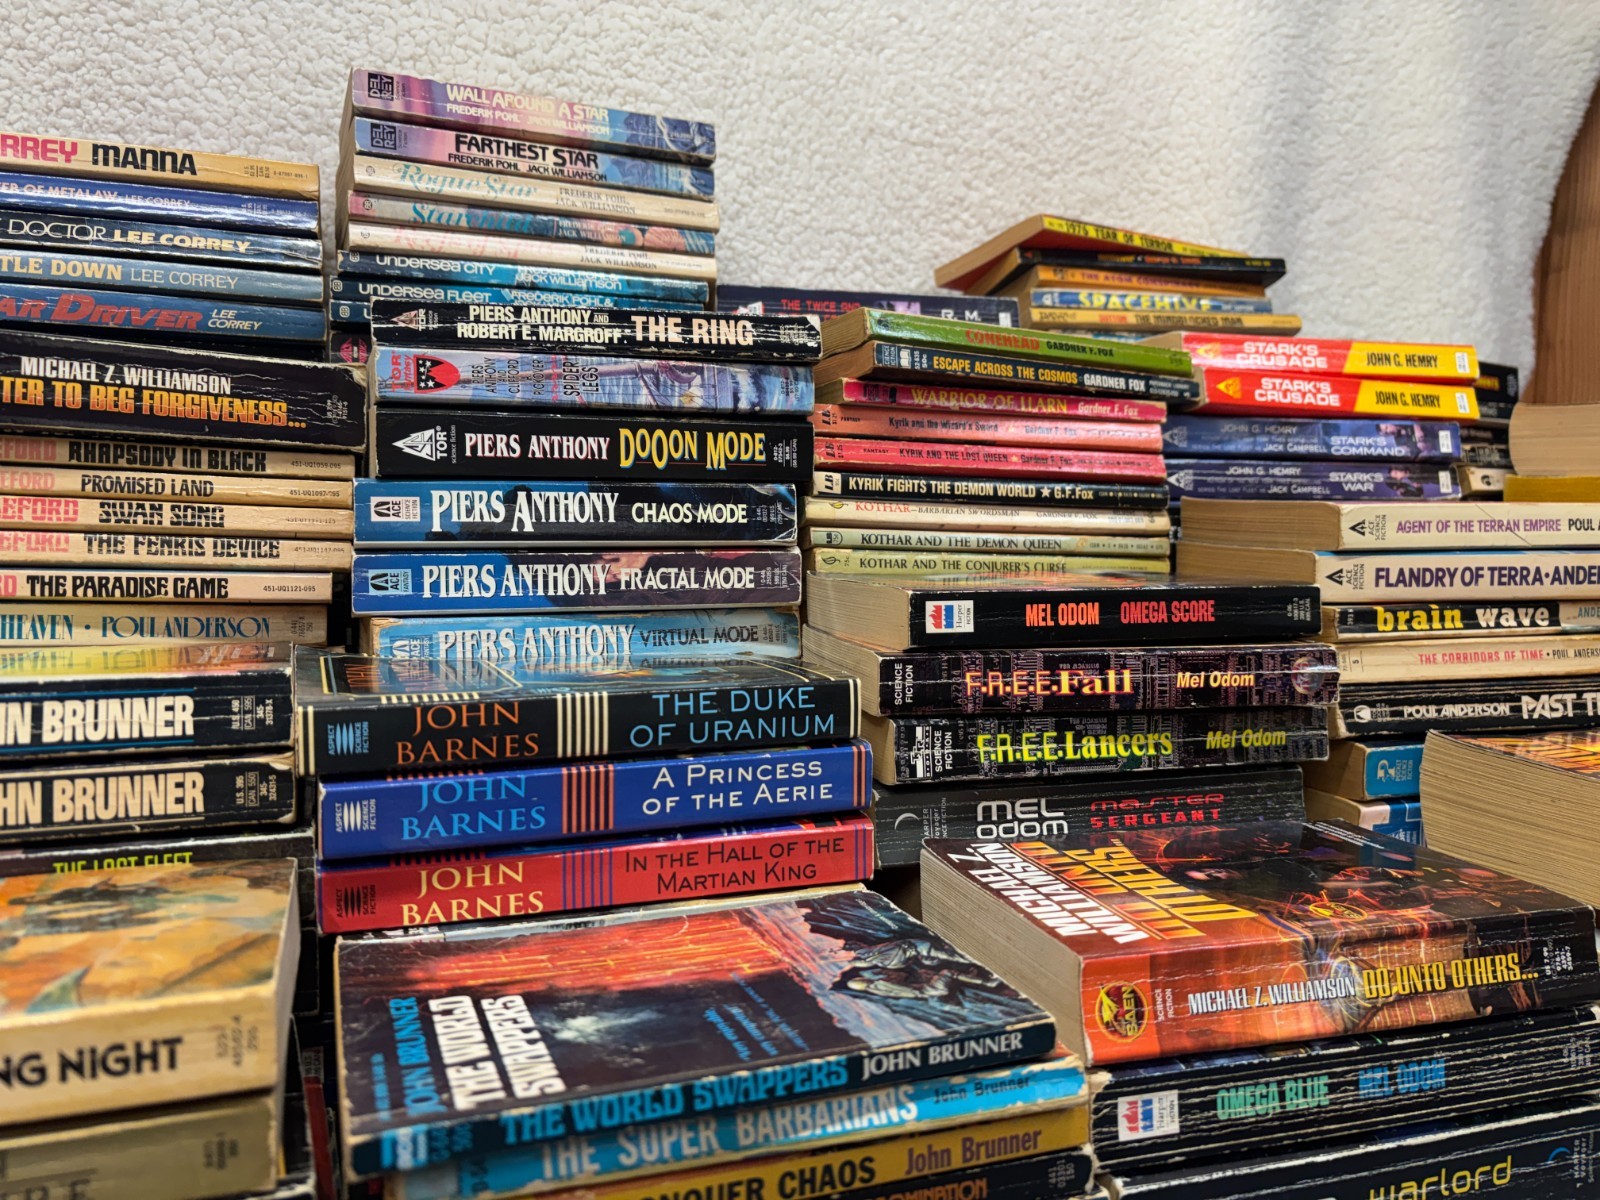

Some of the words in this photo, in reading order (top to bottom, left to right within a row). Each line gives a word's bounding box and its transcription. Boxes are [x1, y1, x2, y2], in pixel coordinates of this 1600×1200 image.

[455, 133, 550, 163] FARTHEST
[552, 148, 599, 170] STAR
[448, 153, 494, 168] FREDERIK
[496, 160, 521, 172] POHL
[526, 163, 551, 176] JACK
[551, 167, 608, 183] WILLIAMSON
[8, 219, 107, 240] DOCTOR
[113, 229, 156, 244] LEE
[160, 233, 251, 253] CORREY
[51, 293, 203, 330] DRIVER
[211, 309, 238, 319] LEE
[207, 319, 263, 331] CORREY
[469, 305, 515, 323] PIERS
[520, 307, 592, 326] ANTHONY
[593, 313, 610, 324] AND
[457, 322, 518, 340] ROBERT
[522, 324, 537, 341] E.
[539, 325, 622, 344] MARGROFF
[1243, 341, 1319, 356] STARK'S
[20, 356, 100, 382] MICHAEL
[104, 365, 121, 384] Z.
[123, 366, 231, 395] WILLIAMSON
[933, 355, 970, 373] ESCAPE
[974, 360, 1013, 377] ACROSS
[1017, 365, 1035, 380] THE
[1038, 369, 1078, 384] COSMOS
[1083, 373, 1126, 389] GARDNER
[1128, 378, 1146, 392] FOX
[1235, 353, 1328, 369] CRUSADE
[1366, 352, 1391, 367] JOHN
[1393, 353, 1403, 367] G.
[1405, 354, 1438, 369] HEMRY
[562, 360, 581, 397] SPIDER
[582, 366, 599, 393] LEGS
[1260, 377, 1331, 393] STARK'S
[1254, 389, 1341, 407] CRUSADE
[1375, 390, 1398, 405] JOHN
[1400, 393, 1410, 407] G.
[1410, 393, 1441, 408] HEMRY
[464, 432, 522, 458] PIERS
[527, 435, 610, 460] ANTHONY
[849, 477, 884, 492] KYRIK
[886, 477, 927, 493] FIGHTS
[930, 480, 951, 494] THE
[954, 481, 994, 496] DEMON
[997, 484, 1036, 498] WORLD
[1329, 471, 1384, 482] STARK'S
[1341, 482, 1374, 492] WAR
[391, 500, 402, 518] ACE
[430, 490, 506, 532] PIERS
[510, 490, 620, 532] ANTHONY
[631, 502, 692, 524] CHAOS
[696, 503, 748, 524] MODE
[860, 533, 913, 546] KOTHAR
[914, 535, 943, 547] AND
[948, 536, 971, 548] THE
[976, 537, 1019, 549] DEMON
[1023, 539, 1062, 551] QUEEN
[1396, 520, 1433, 534] AGENT
[1436, 519, 1450, 533] OF
[1453, 519, 1475, 533] THE
[1477, 518, 1521, 532] TERRAN
[1523, 518, 1562, 532] EMPIRE
[1568, 518, 1595, 531] POUL
[83, 533, 125, 555] THE
[133, 535, 206, 557] FENRIS
[212, 538, 280, 559] DEVICE
[26, 575, 67, 597] THE
[72, 575, 169, 598] PARADISE
[173, 577, 229, 599] GAME
[422, 564, 497, 599] PIERS
[500, 563, 611, 598] ANTHONY
[619, 567, 700, 590] FRACTAL
[704, 566, 755, 590] MODE
[1025, 603, 1055, 627] MEL
[1057, 602, 1100, 626] ODOM
[1120, 600, 1168, 624] OMEGA
[1171, 599, 1215, 623] SCORE
[1376, 605, 1464, 632] brain
[1475, 606, 1550, 628] wave
[639, 627, 709, 648] VIRTUAL
[713, 625, 759, 645] MODE
[1419, 652, 1438, 665] THE
[1441, 651, 1500, 665] CORRIDORS
[1504, 650, 1516, 662] OF
[1520, 649, 1544, 661] TIME
[894, 662, 903, 706] SCIENCE
[905, 664, 914, 703] FICTION
[1176, 671, 1205, 689] Mel
[1209, 670, 1255, 688] Odom
[652, 692, 718, 716] THE
[731, 686, 816, 713] DUKE
[41, 695, 195, 744] BRUNNER
[412, 701, 520, 738] JOHN
[629, 723, 677, 748] OF
[689, 713, 835, 744] URANIUM
[396, 732, 540, 765] BARNES
[934, 729, 943, 773] SCIENCE
[944, 731, 953, 770] FICTION
[418, 775, 527, 813] JOHN
[652, 767, 675, 790] A
[52, 772, 205, 823] BRUNNER
[642, 795, 680, 815] OF
[690, 791, 743, 810] THE
[335, 802, 343, 833] ASPECT
[369, 798, 377, 830] FICTION
[400, 805, 546, 840] BARNES
[1090, 808, 1221, 829] SERGEANT
[416, 861, 525, 899] JOHN
[400, 890, 545, 926] BARNES
[1362, 966, 1395, 999] DO
[1395, 960, 1447, 995] UNTO
[1450, 952, 1539, 989] OTHERS...
[1123, 986, 1137, 1037] BAEN
[1153, 988, 1163, 1022] SCIENCE
[1165, 987, 1173, 1019] FICTION
[1187, 987, 1250, 1017] MICHAEL
[1253, 985, 1268, 1007] Z.
[1268, 977, 1356, 1005] WILLIAMSON
[428, 995, 493, 1065] WORLD
[59, 1036, 183, 1083] NIGHT
[480, 994, 569, 1100] SWAPPERS
[861, 1049, 922, 1081] JOHN
[928, 1031, 1023, 1065] BRUNNER
[444, 1060, 507, 1112] THE
[933, 1086, 968, 1104] John
[973, 1076, 1031, 1097] Brunner
[1358, 1066, 1394, 1100] MEL
[1396, 1058, 1447, 1094] ODOM
[501, 1103, 567, 1145] THE
[571, 1083, 685, 1132] WORLD
[692, 1056, 849, 1112] SWAPPERS
[1215, 1082, 1281, 1121] OMEGA
[1284, 1075, 1330, 1111] BLUE
[905, 1144, 951, 1176] John
[962, 1129, 1043, 1164] Brunner
[778, 1156, 877, 1198] CHAOS
